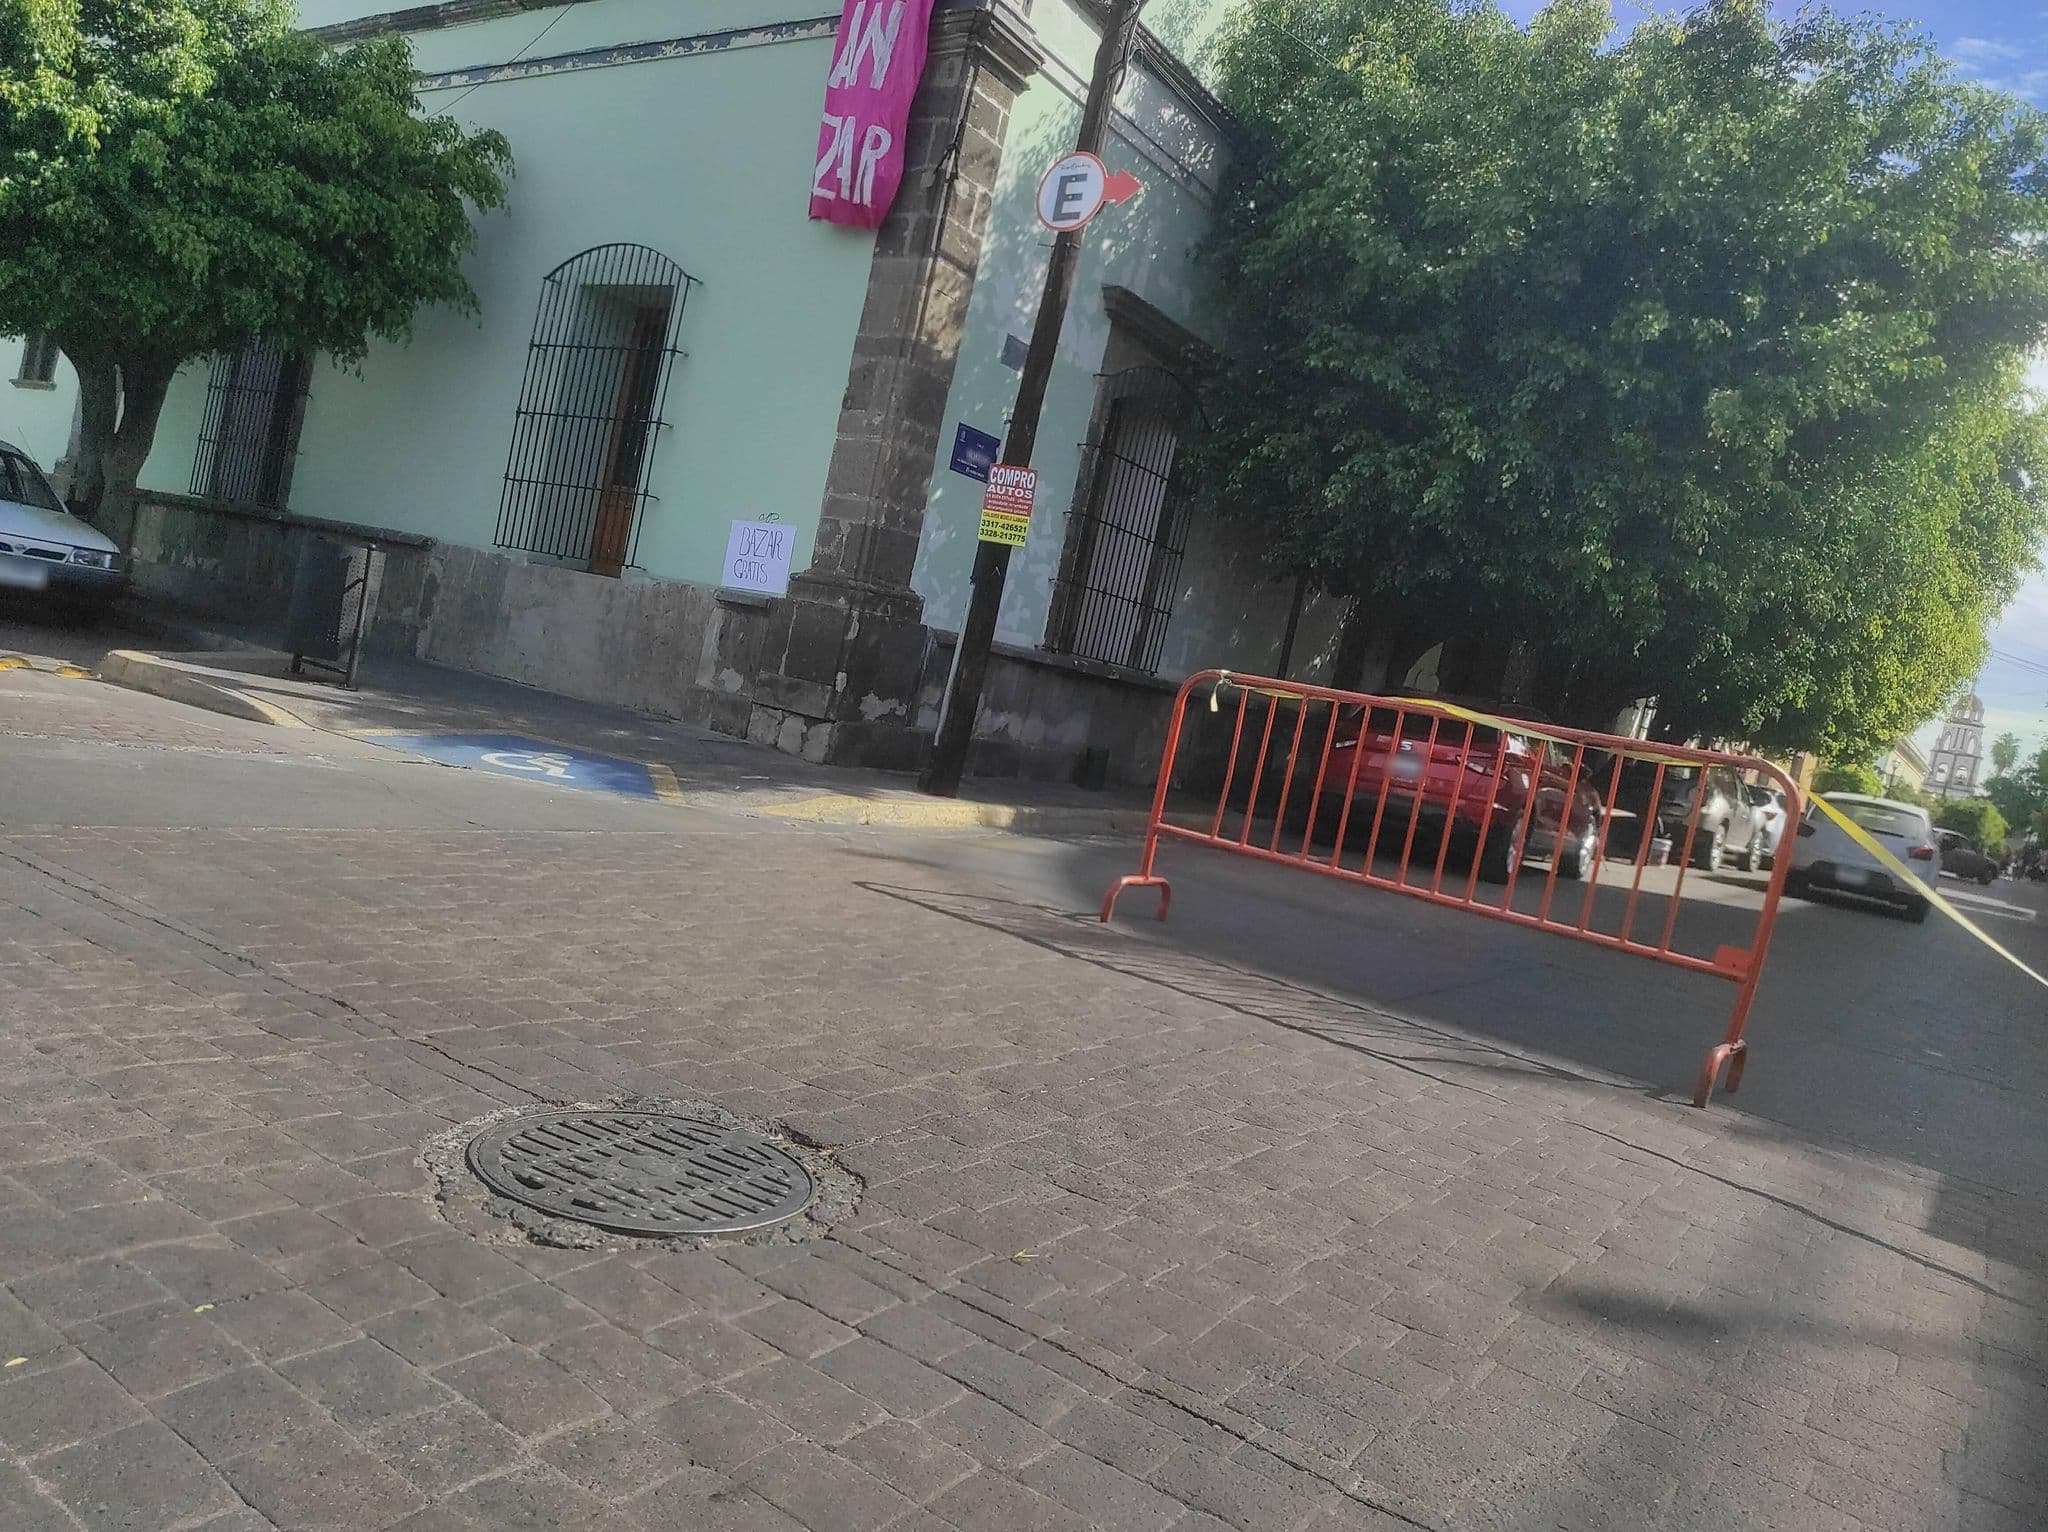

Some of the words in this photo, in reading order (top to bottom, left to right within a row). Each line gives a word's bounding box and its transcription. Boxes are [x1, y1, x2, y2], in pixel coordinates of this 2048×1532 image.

[813, 112, 892, 208] ZAR
[1053, 173, 1088, 222] E
[987, 484, 1033, 499] AUTOS
[990, 467, 1036, 489] COMPRO
[739, 527, 783, 561] BAZAR
[733, 558, 768, 585] GRATIS
